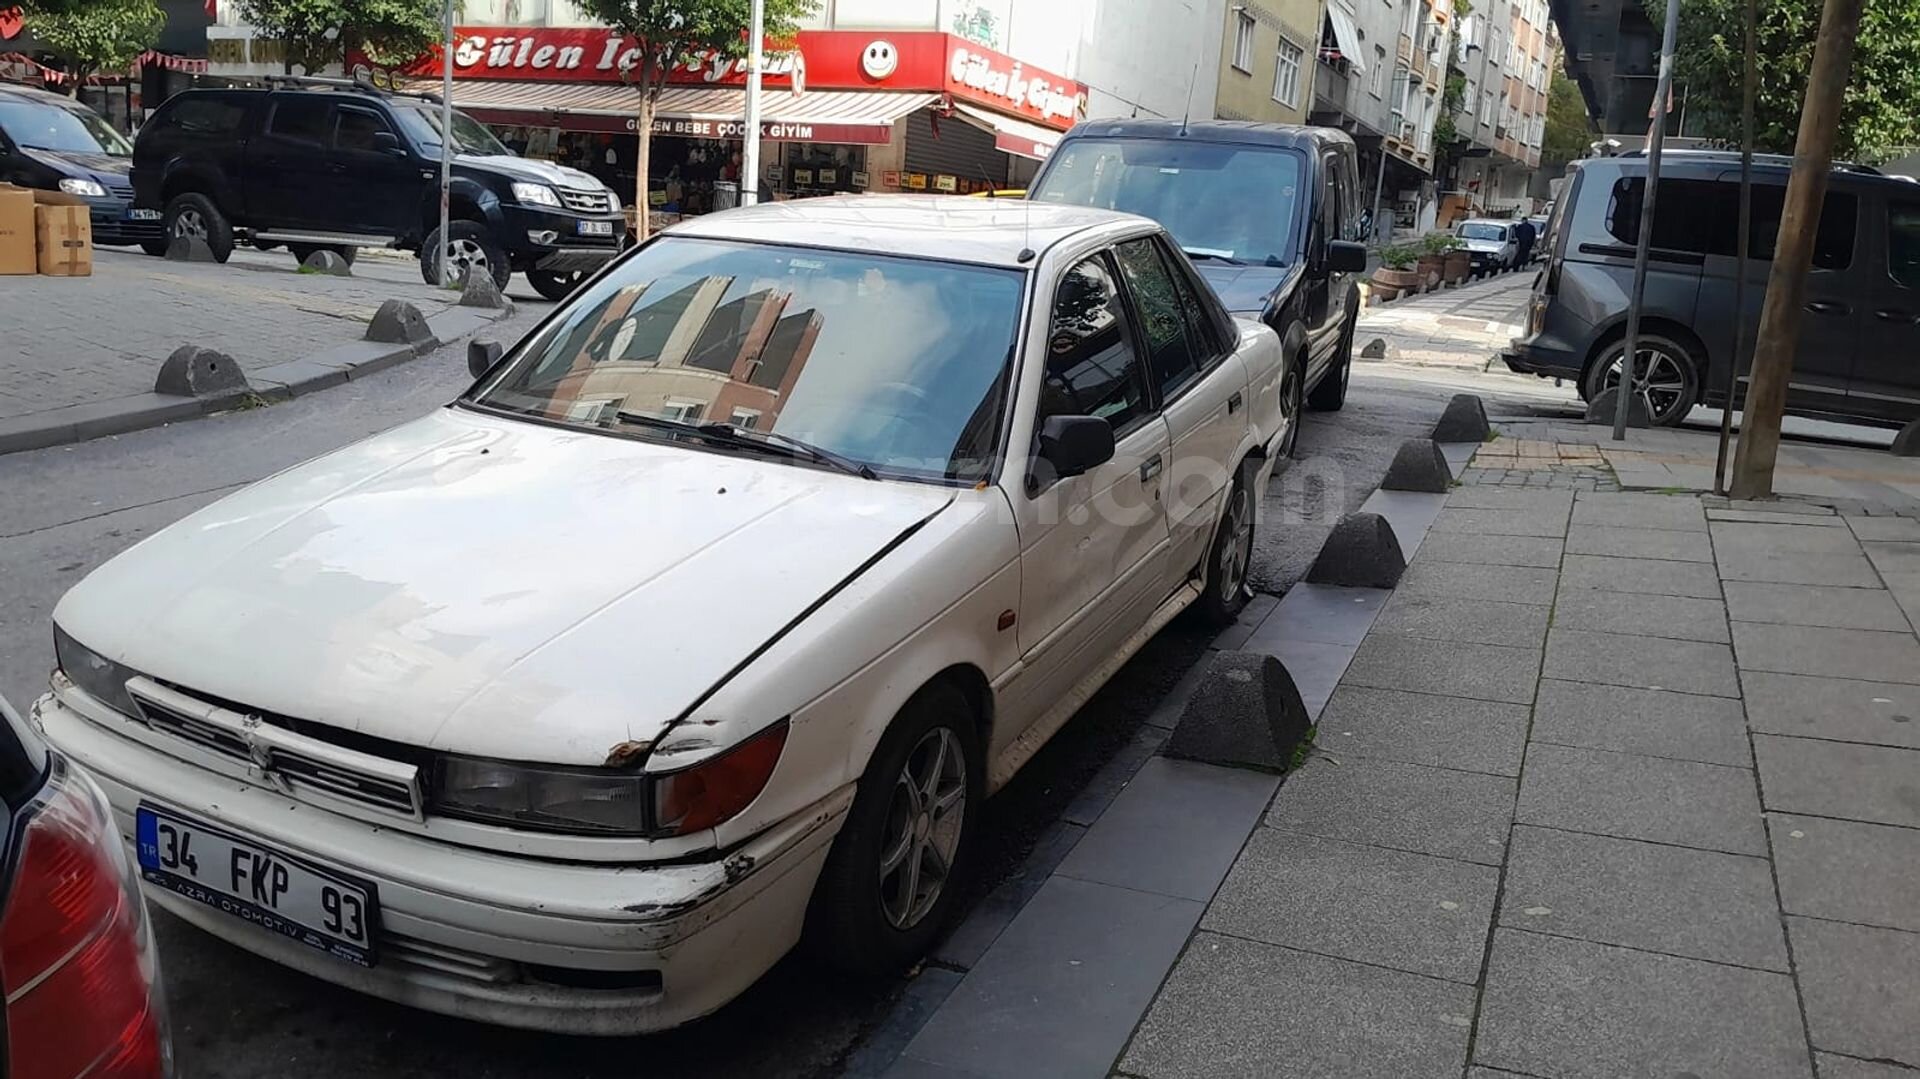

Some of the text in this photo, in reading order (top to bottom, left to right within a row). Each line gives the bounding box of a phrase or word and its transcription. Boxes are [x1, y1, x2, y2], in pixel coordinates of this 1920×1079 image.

[455, 35, 584, 69] Gülen
[675, 122, 711, 135] BEBE
[717, 123, 766, 137] ÇOCK
[770, 122, 813, 138] GİYİM
[141, 842, 157, 858] TR
[159, 824, 364, 941] 34 FKP 93
[176, 882, 216, 906] AZRA
